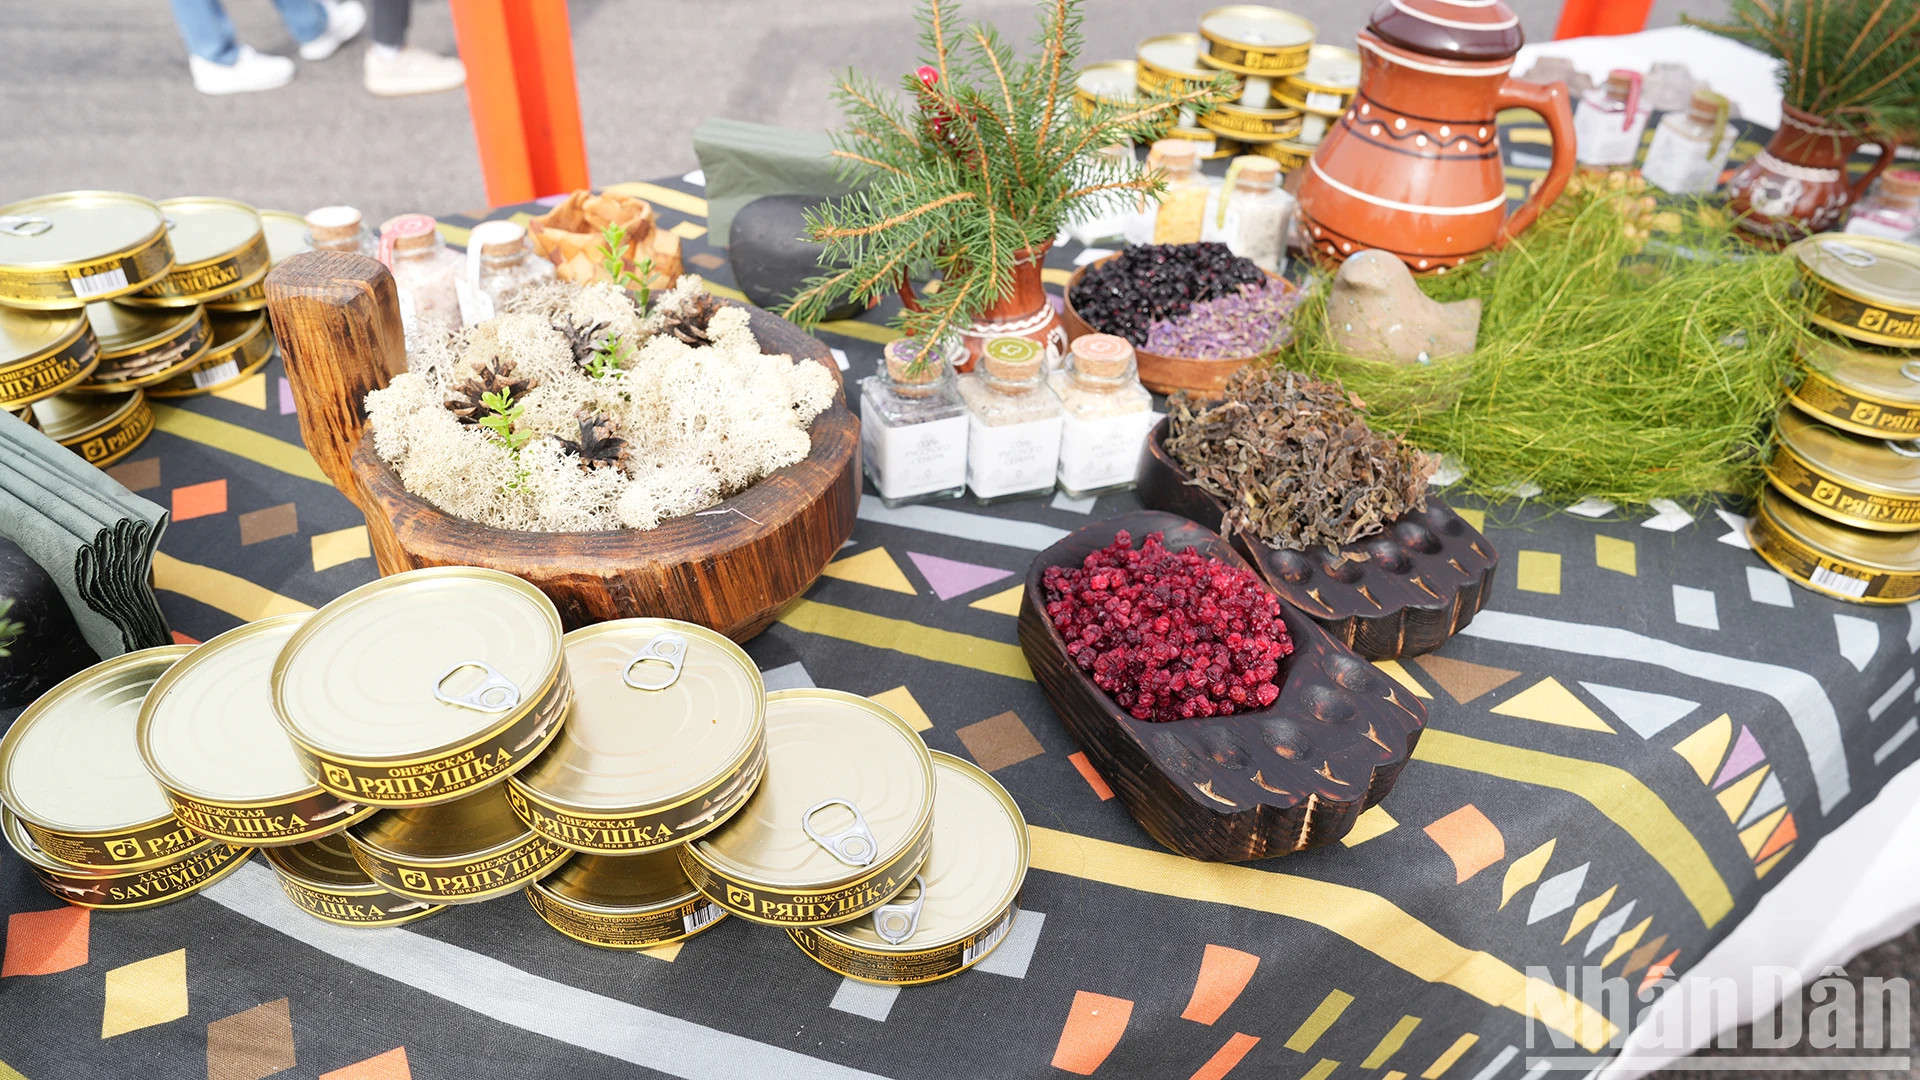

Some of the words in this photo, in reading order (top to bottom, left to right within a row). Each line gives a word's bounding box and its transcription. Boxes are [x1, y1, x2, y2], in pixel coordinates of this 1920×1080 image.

[356, 747, 513, 794] РЯПУШКА
[388, 750, 476, 777] ОНЕЖСКАЯ
[412, 780, 466, 798] копченая
[480, 761, 510, 780] масле
[169, 797, 309, 833] РЯПУШКА
[188, 801, 266, 817] ОНЕЖСКАЯ
[556, 814, 636, 828] ОНЕЖСКАЯ
[272, 827, 306, 837] масле
[531, 809, 674, 844] РЯПУШКА
[638, 836, 670, 847] масле
[465, 840, 541, 873] ОНЕЖСКАЯ
[760, 877, 896, 918] РЯПУШКА
[793, 882, 870, 904] ОНЕЖСКАЯ
